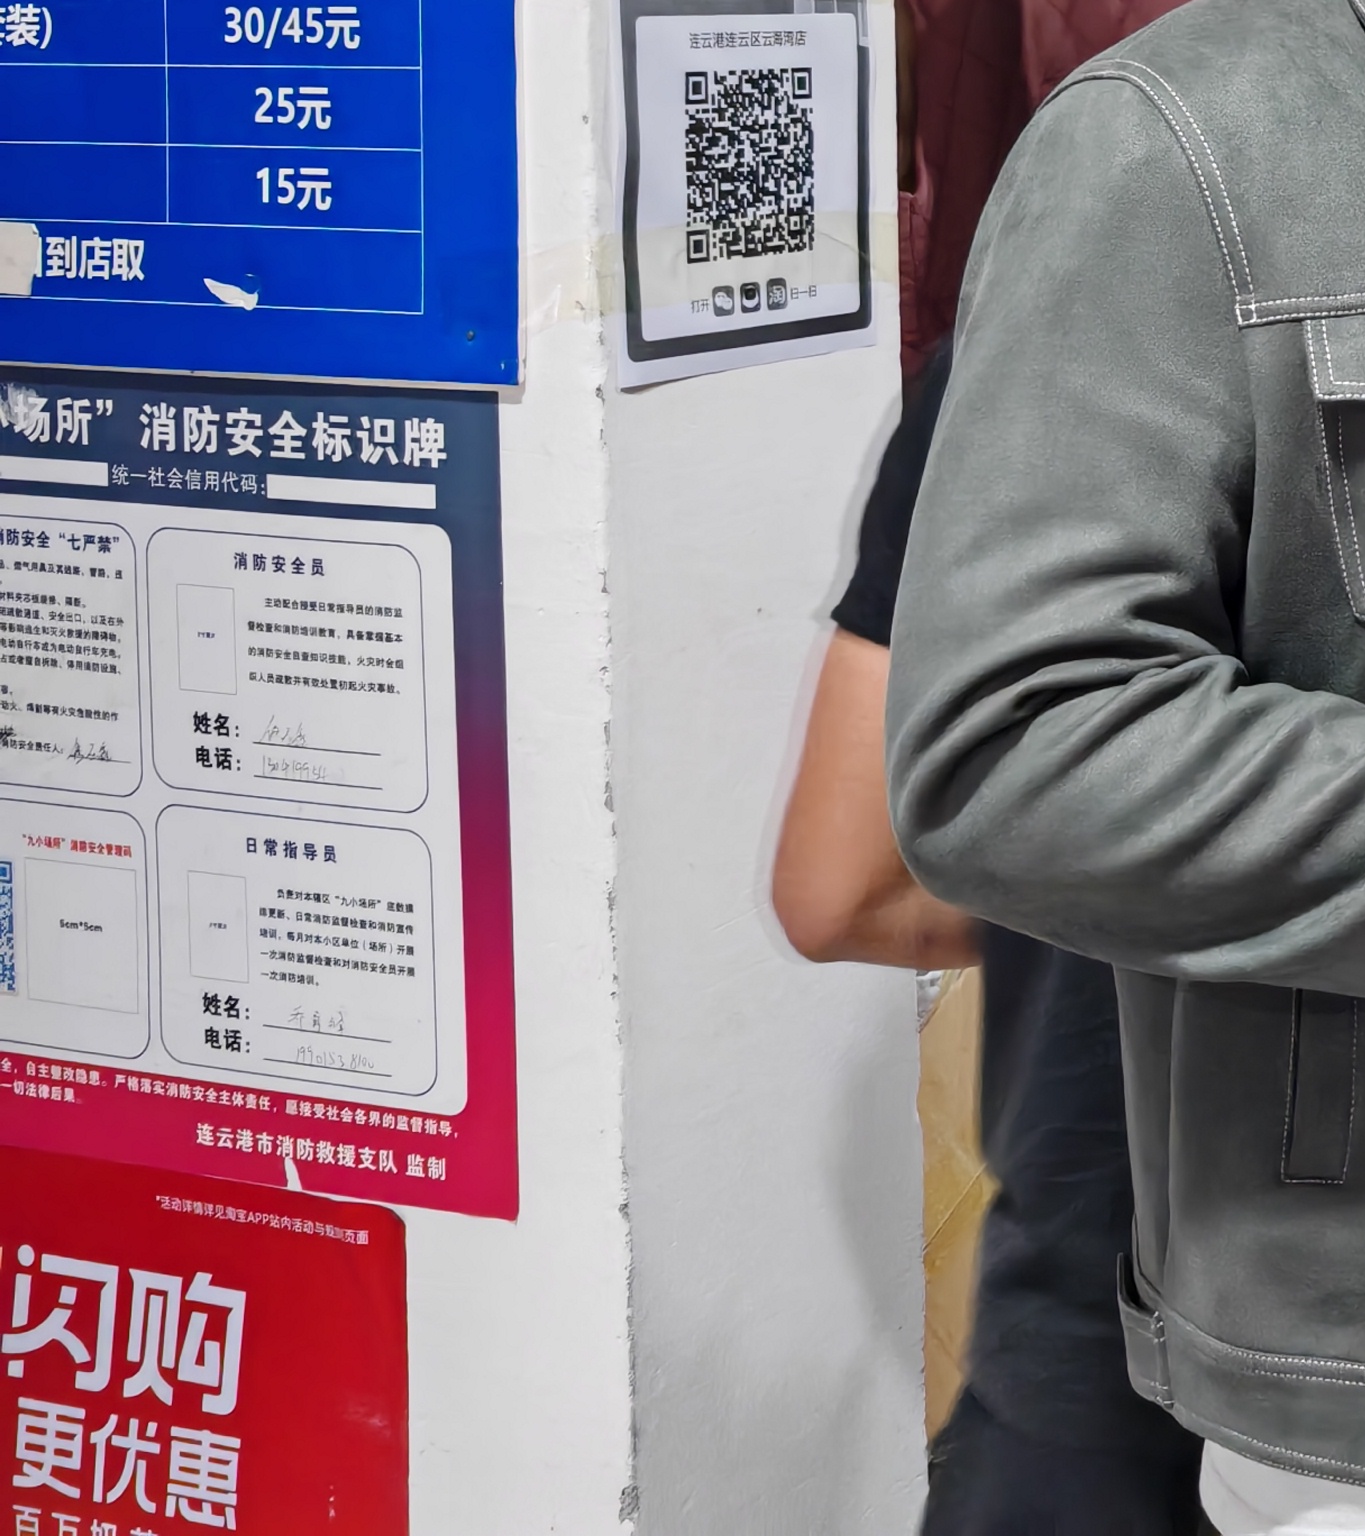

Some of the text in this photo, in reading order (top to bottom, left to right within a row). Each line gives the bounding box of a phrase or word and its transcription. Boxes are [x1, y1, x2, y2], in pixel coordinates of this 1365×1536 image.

[225, 7, 360, 49] 30/45元
[255, 87, 331, 129] 25元
[257, 167, 332, 210] 15元
[36, 237, 145, 280] 到店取
[234, 552, 324, 576] 消防安全员
[247, 838, 336, 863] 日常指导员
[1, 1244, 247, 1416] 闪购
[12, 1396, 241, 1530] 更优惠
